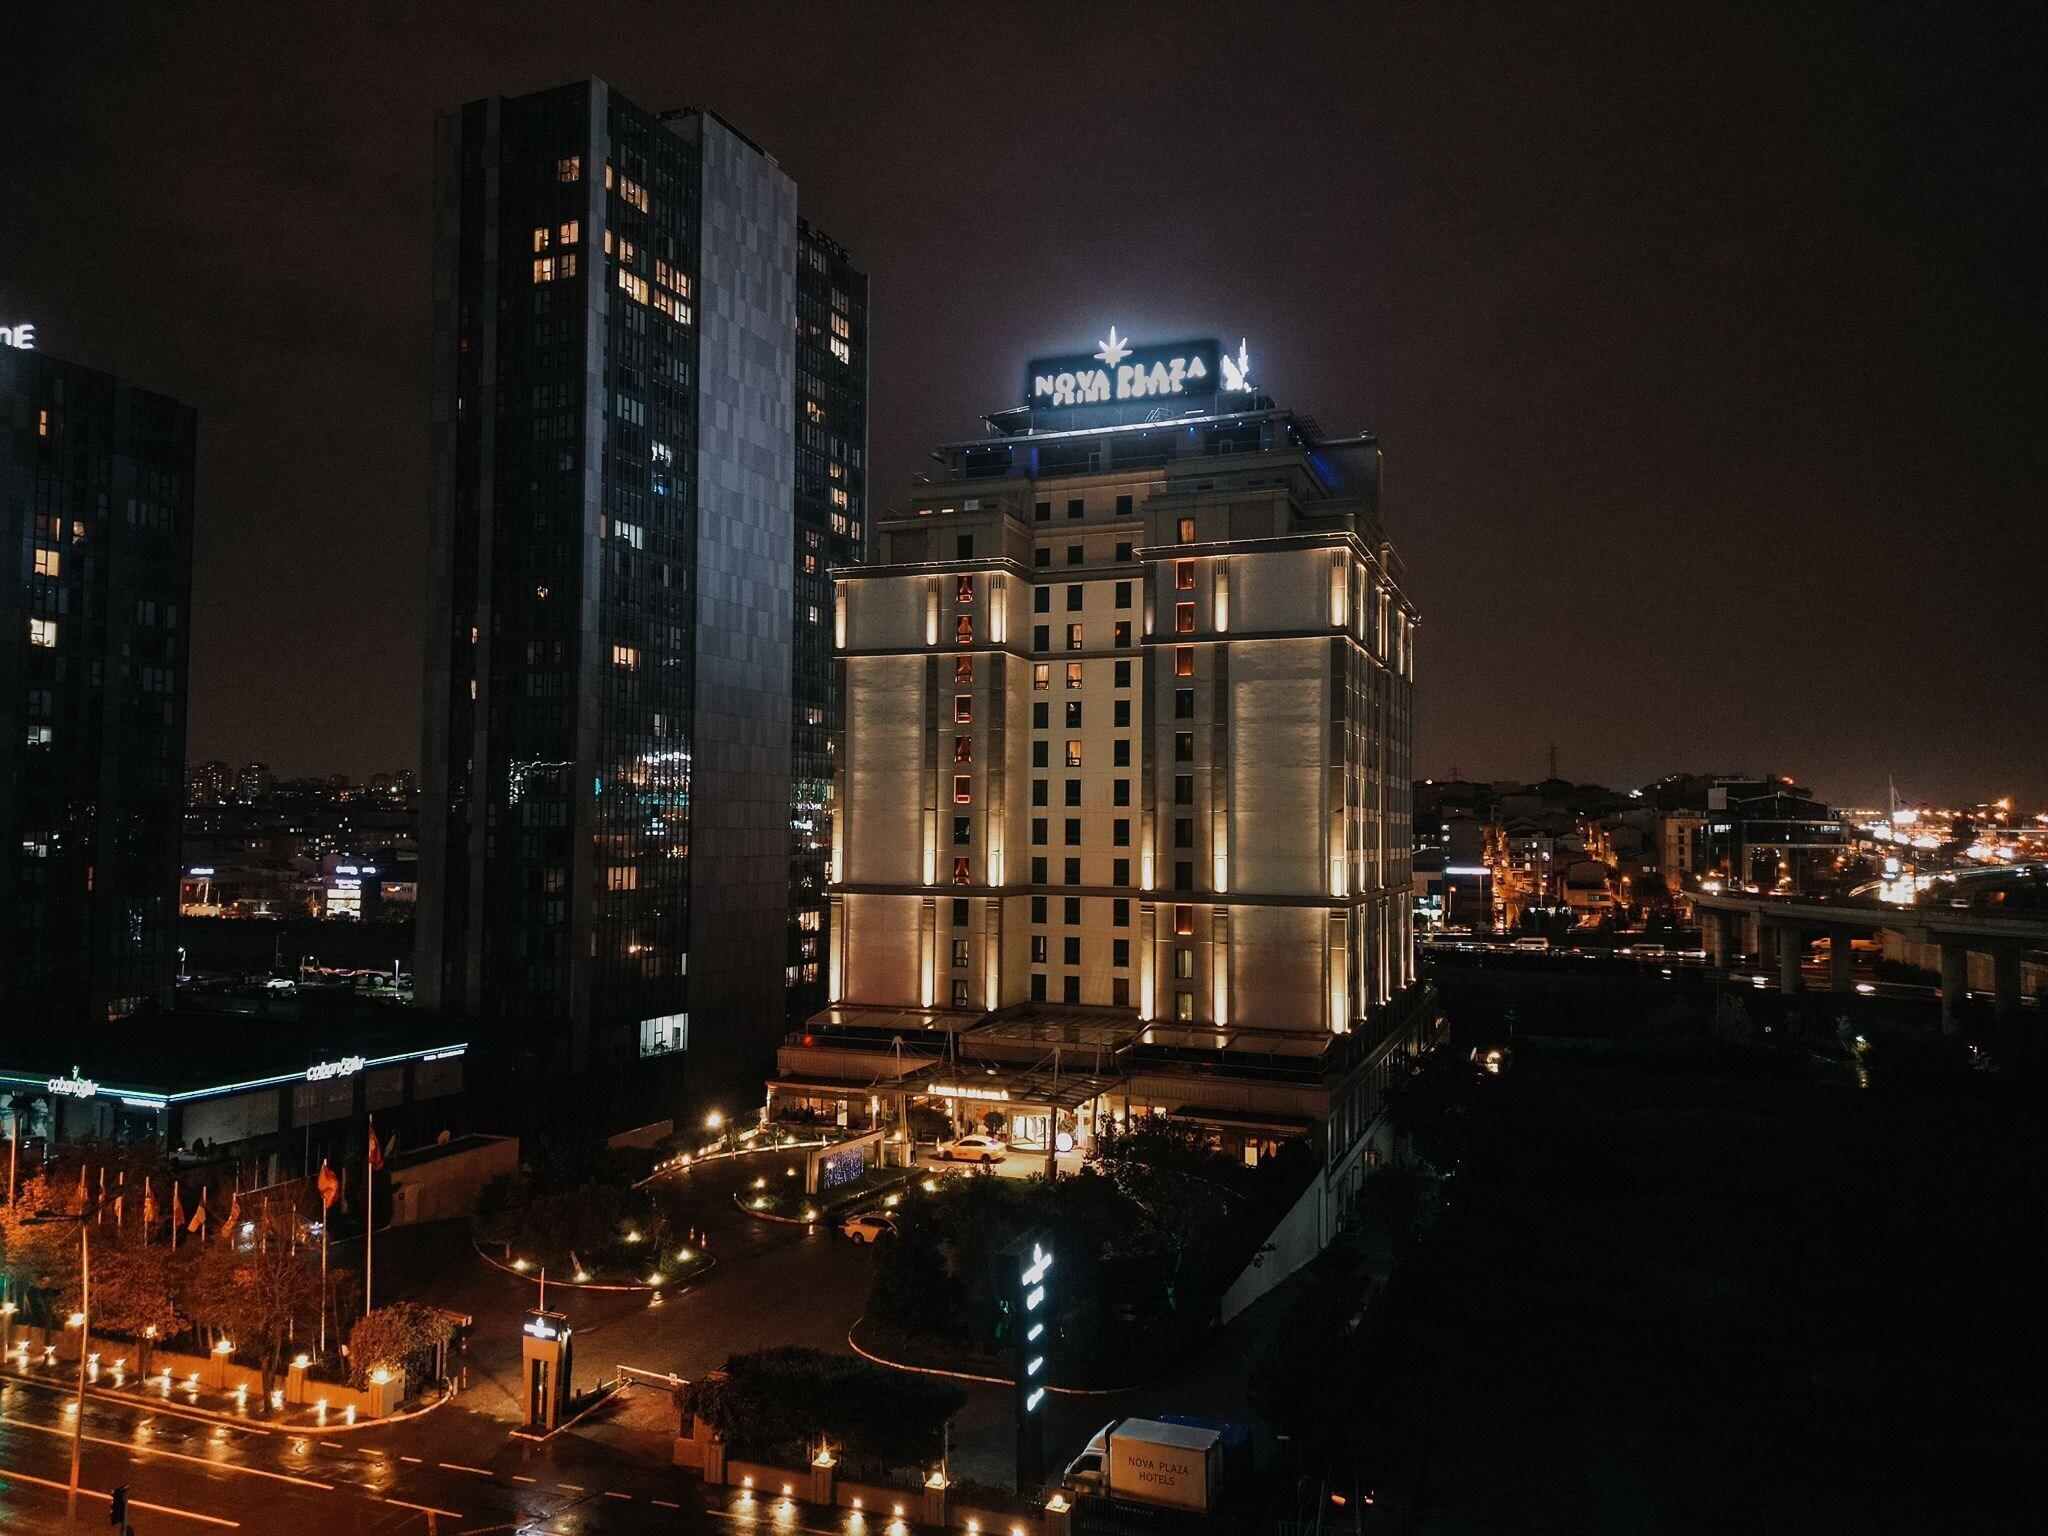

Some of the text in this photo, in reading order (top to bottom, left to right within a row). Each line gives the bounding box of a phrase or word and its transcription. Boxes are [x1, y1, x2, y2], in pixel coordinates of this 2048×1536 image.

[1035, 368, 1110, 397] NOVA
[1117, 355, 1207, 388] PLAZA
[1128, 1456, 1189, 1475] NOVA PLAZA
[1139, 1471, 1176, 1486] HOTELS
